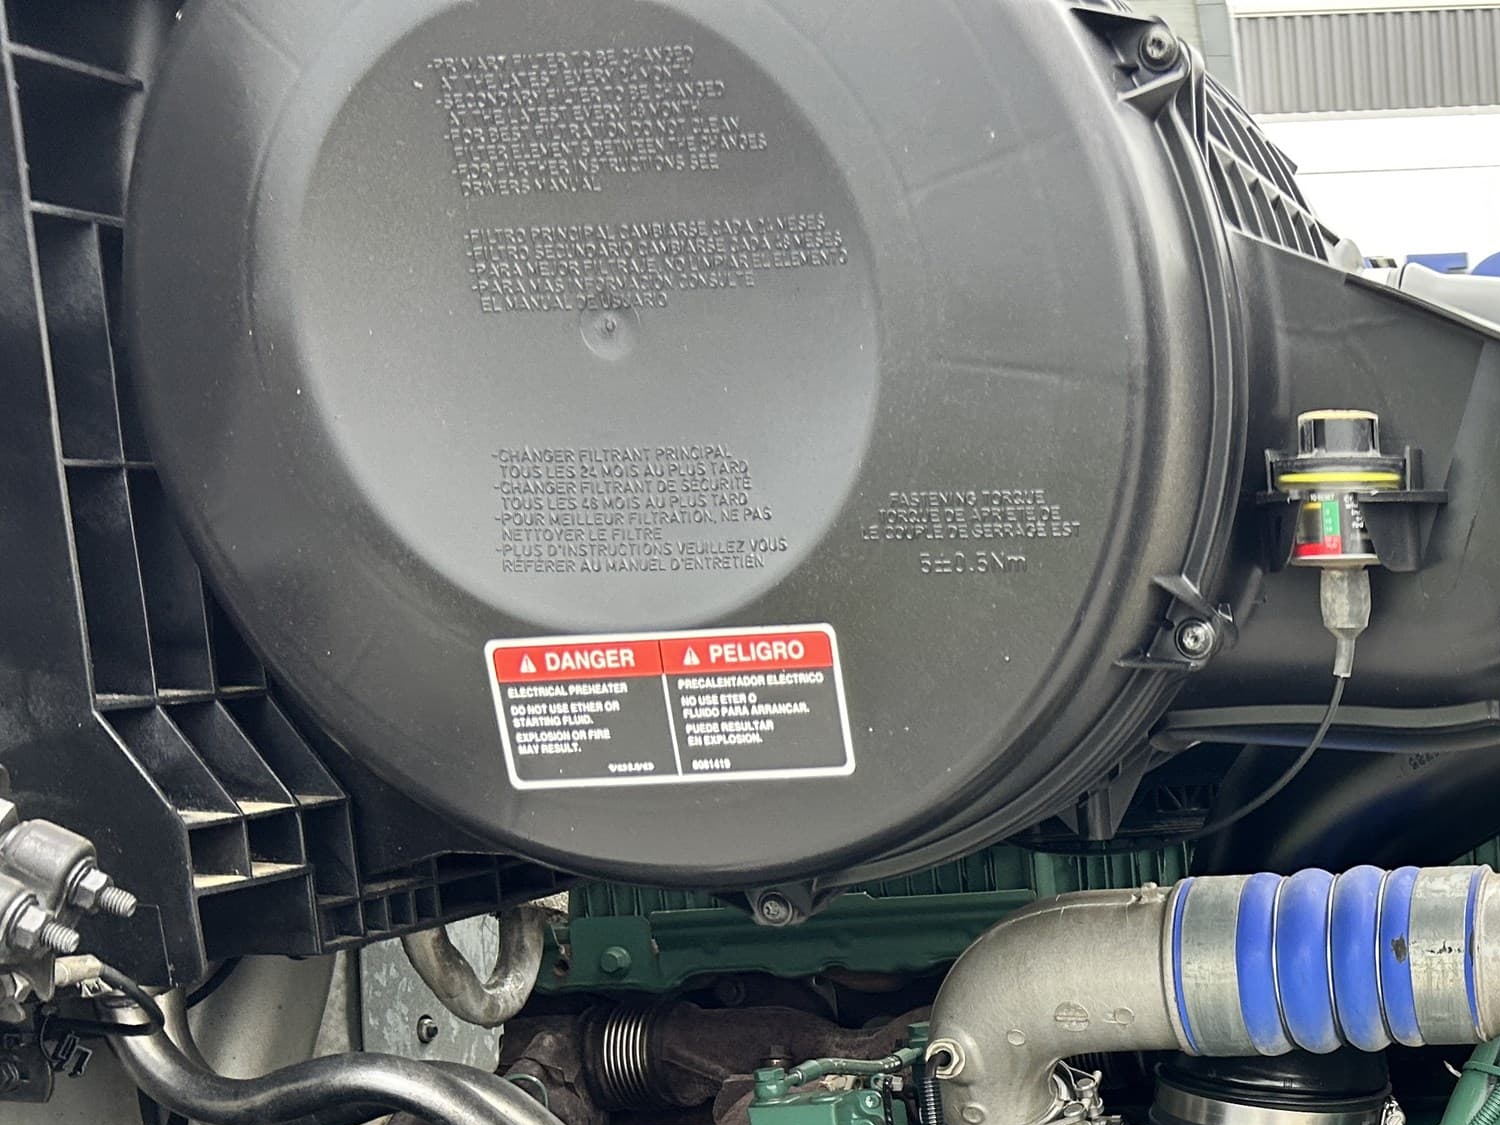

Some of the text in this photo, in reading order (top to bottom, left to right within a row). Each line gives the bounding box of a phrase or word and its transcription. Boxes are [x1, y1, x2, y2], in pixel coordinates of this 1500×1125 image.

[579, 446, 650, 462] FILTRANT
[656, 444, 732, 461] PRINCIPAL
[500, 463, 543, 479] TOUS
[546, 463, 577, 479] LES
[602, 462, 640, 478] MOIS
[644, 461, 665, 478] AU
[669, 461, 707, 477] PLUS
[711, 459, 749, 475] TARD
[580, 478, 654, 494] FILTRANT
[657, 478, 677, 493] DE
[501, 496, 545, 511] TOUS
[548, 496, 578, 511] LES
[602, 495, 641, 511] MOIS
[645, 494, 666, 510] AU
[670, 493, 708, 509] PLUS
[711, 491, 749, 507] TARD
[889, 489, 1047, 507] FASTENING TORQUE
[549, 510, 625, 527] MEILLEUR
[721, 508, 741, 522] NE
[744, 506, 773, 521] PAS
[945, 507, 966, 523] DE
[1040, 504, 1062, 521] DE
[502, 526, 662, 542] NETTOYER LE FILTRE
[885, 523, 945, 540] COUPLE
[948, 522, 968, 539] DE
[971, 521, 1046, 538] SERRAGE
[1050, 520, 1081, 537] EST
[676, 539, 745, 555] VEUILLEZ
[749, 537, 788, 553] VOUS
[581, 557, 602, 573] AU
[709, 639, 806, 663] PELIGRO
[545, 649, 636, 671] DANGER
[507, 682, 628, 699] ELECTRICAL PREHEATER
[678, 676, 765, 690] PRECALENTADOR
[681, 695, 697, 706] NO
[698, 694, 720, 705] USE
[748, 692, 758, 703] O
[511, 701, 621, 716] DO NOT USE ETHER OR
[683, 702, 810, 719] FLUIDO PARA ARRANCAR.
[512, 715, 594, 728] STARTING FLUID.
[686, 719, 775, 734] PUEDE RESULTAR
[516, 729, 611, 744] EXPLOSION OR FIRE
[688, 735, 703, 746] EN
[518, 743, 582, 756] MAY RESULT.
